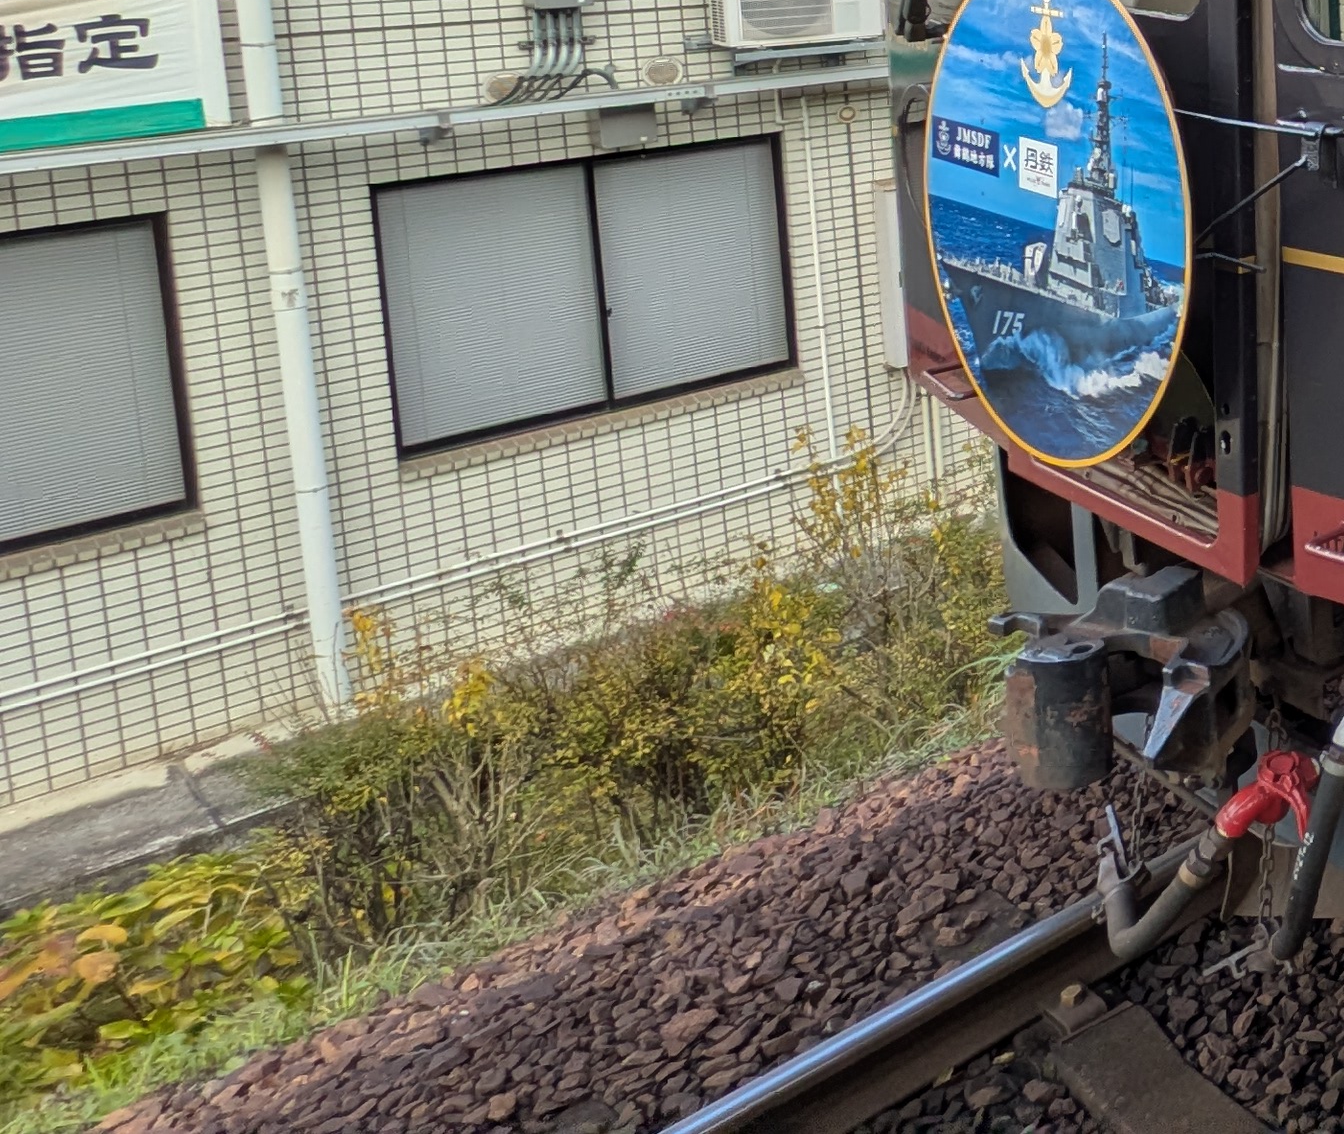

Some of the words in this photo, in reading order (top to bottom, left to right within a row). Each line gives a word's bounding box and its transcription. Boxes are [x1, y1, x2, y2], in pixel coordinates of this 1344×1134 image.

[0, 13, 159, 82] 指定
[955, 126, 992, 150] JMSDF
[1024, 147, 1054, 174] 丹鉄
[992, 310, 1026, 336] 175
